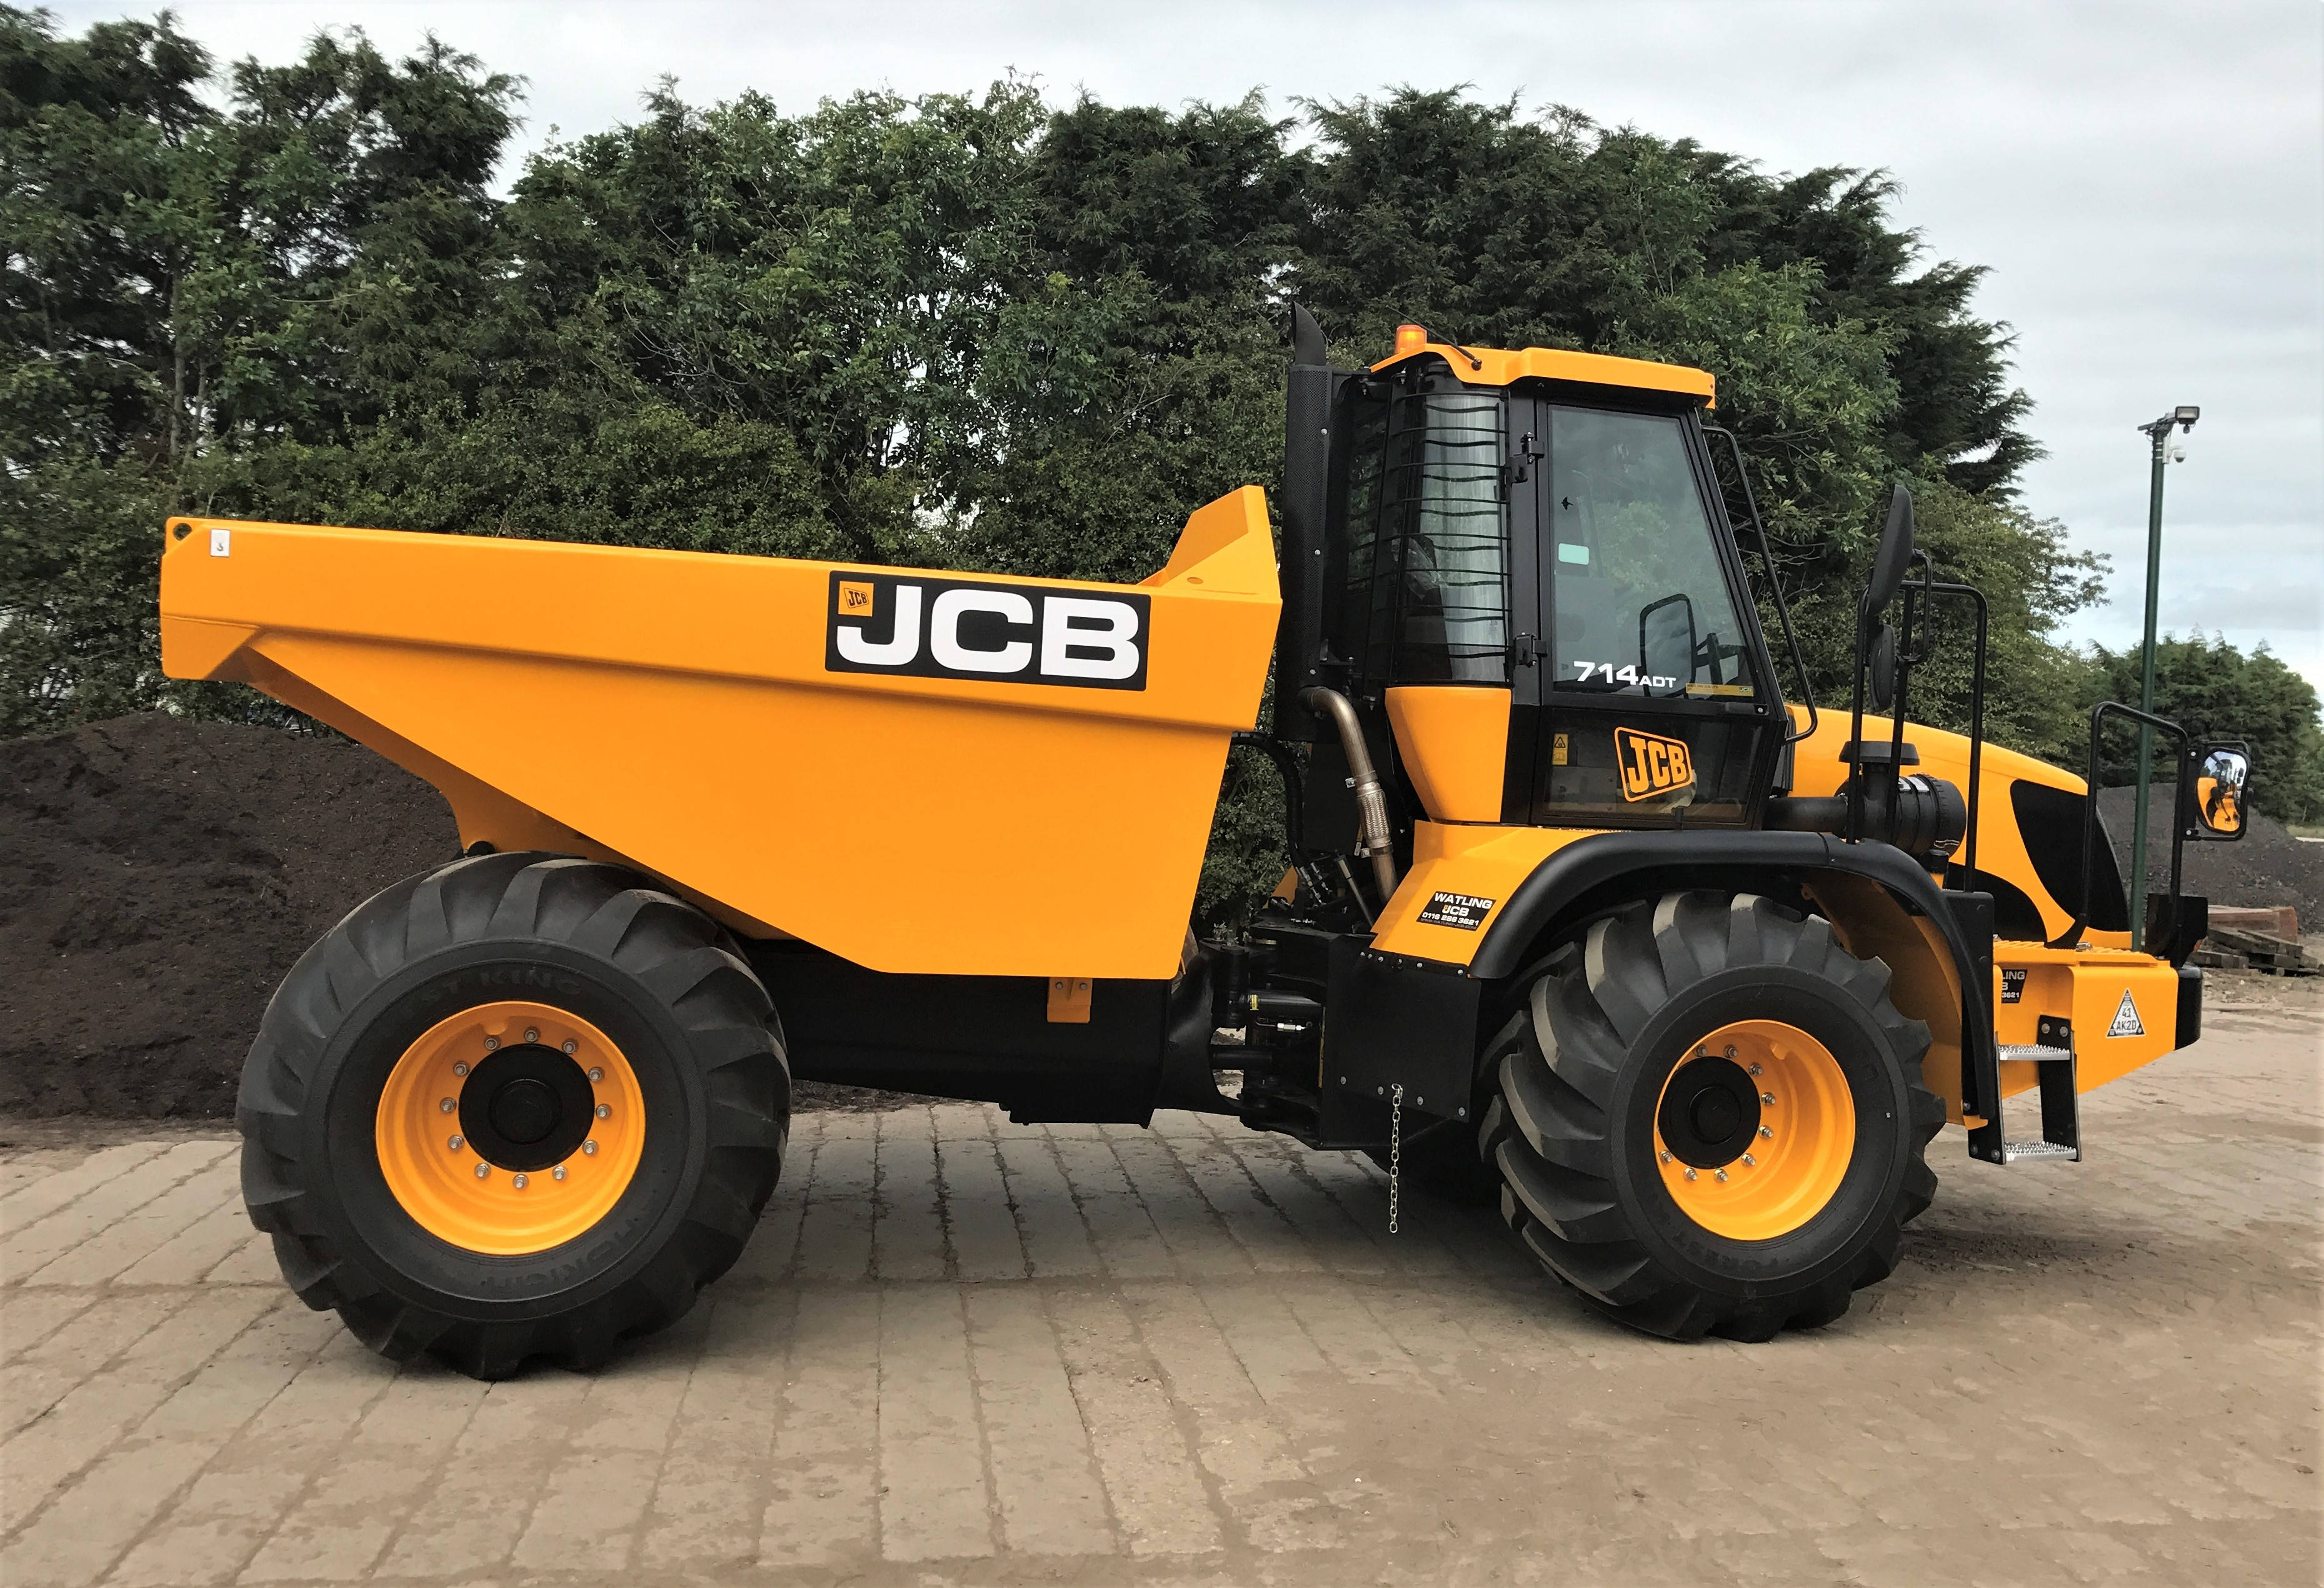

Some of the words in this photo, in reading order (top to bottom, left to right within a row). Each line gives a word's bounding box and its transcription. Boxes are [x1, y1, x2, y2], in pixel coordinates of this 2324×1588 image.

[848, 590, 868, 606] JCB
[837, 585, 1139, 680] JCB
[1626, 736, 1687, 793] JCB
[1435, 892, 1493, 910] WATLING
[1422, 912, 1441, 920] 0116
[1458, 917, 1480, 927] 3621
[1442, 905, 1470, 917] JCB
